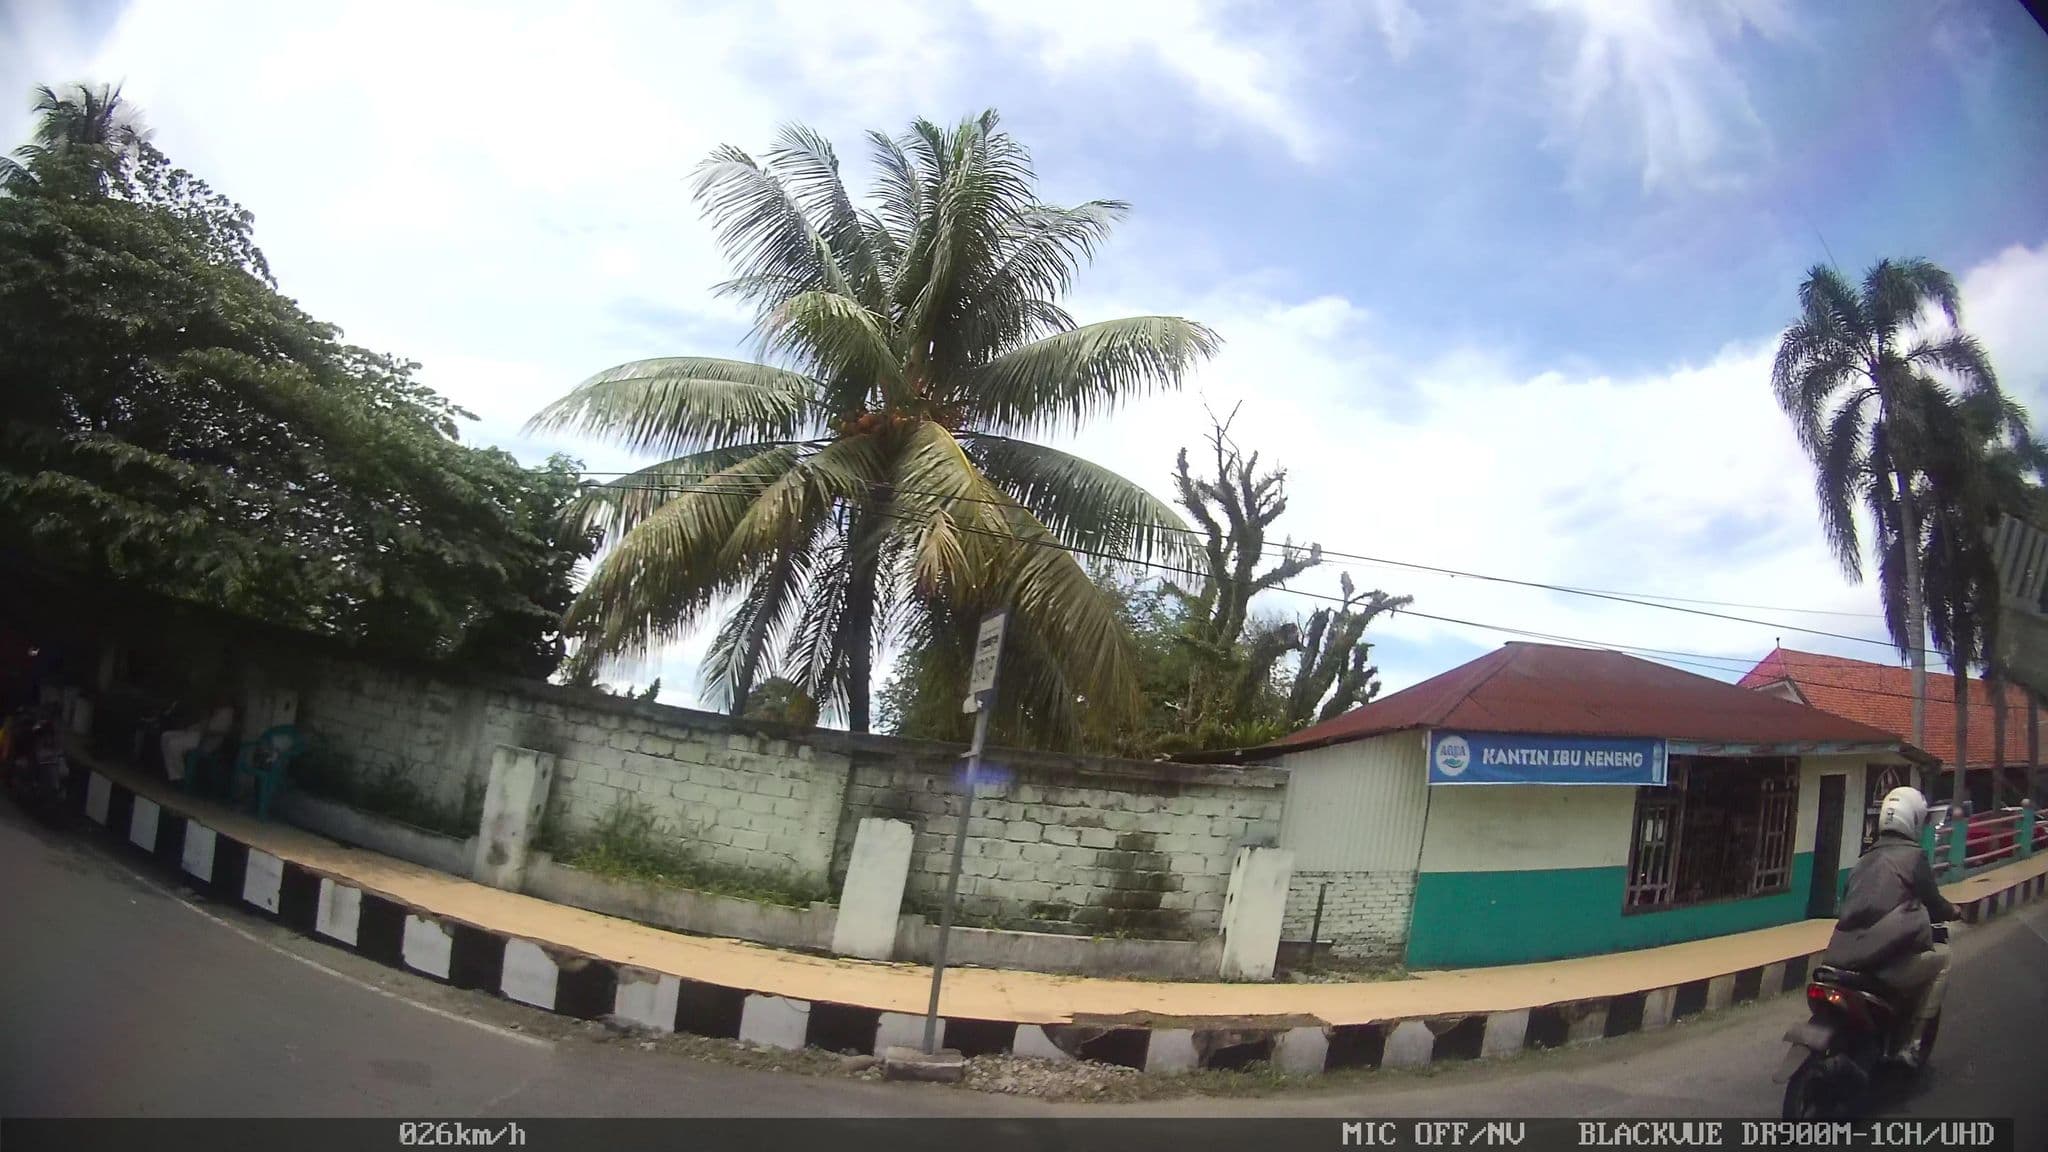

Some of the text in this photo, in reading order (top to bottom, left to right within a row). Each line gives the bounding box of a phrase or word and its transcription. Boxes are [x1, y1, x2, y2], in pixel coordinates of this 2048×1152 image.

[1482, 748, 1643, 768] KANTIN IBU NENENG
